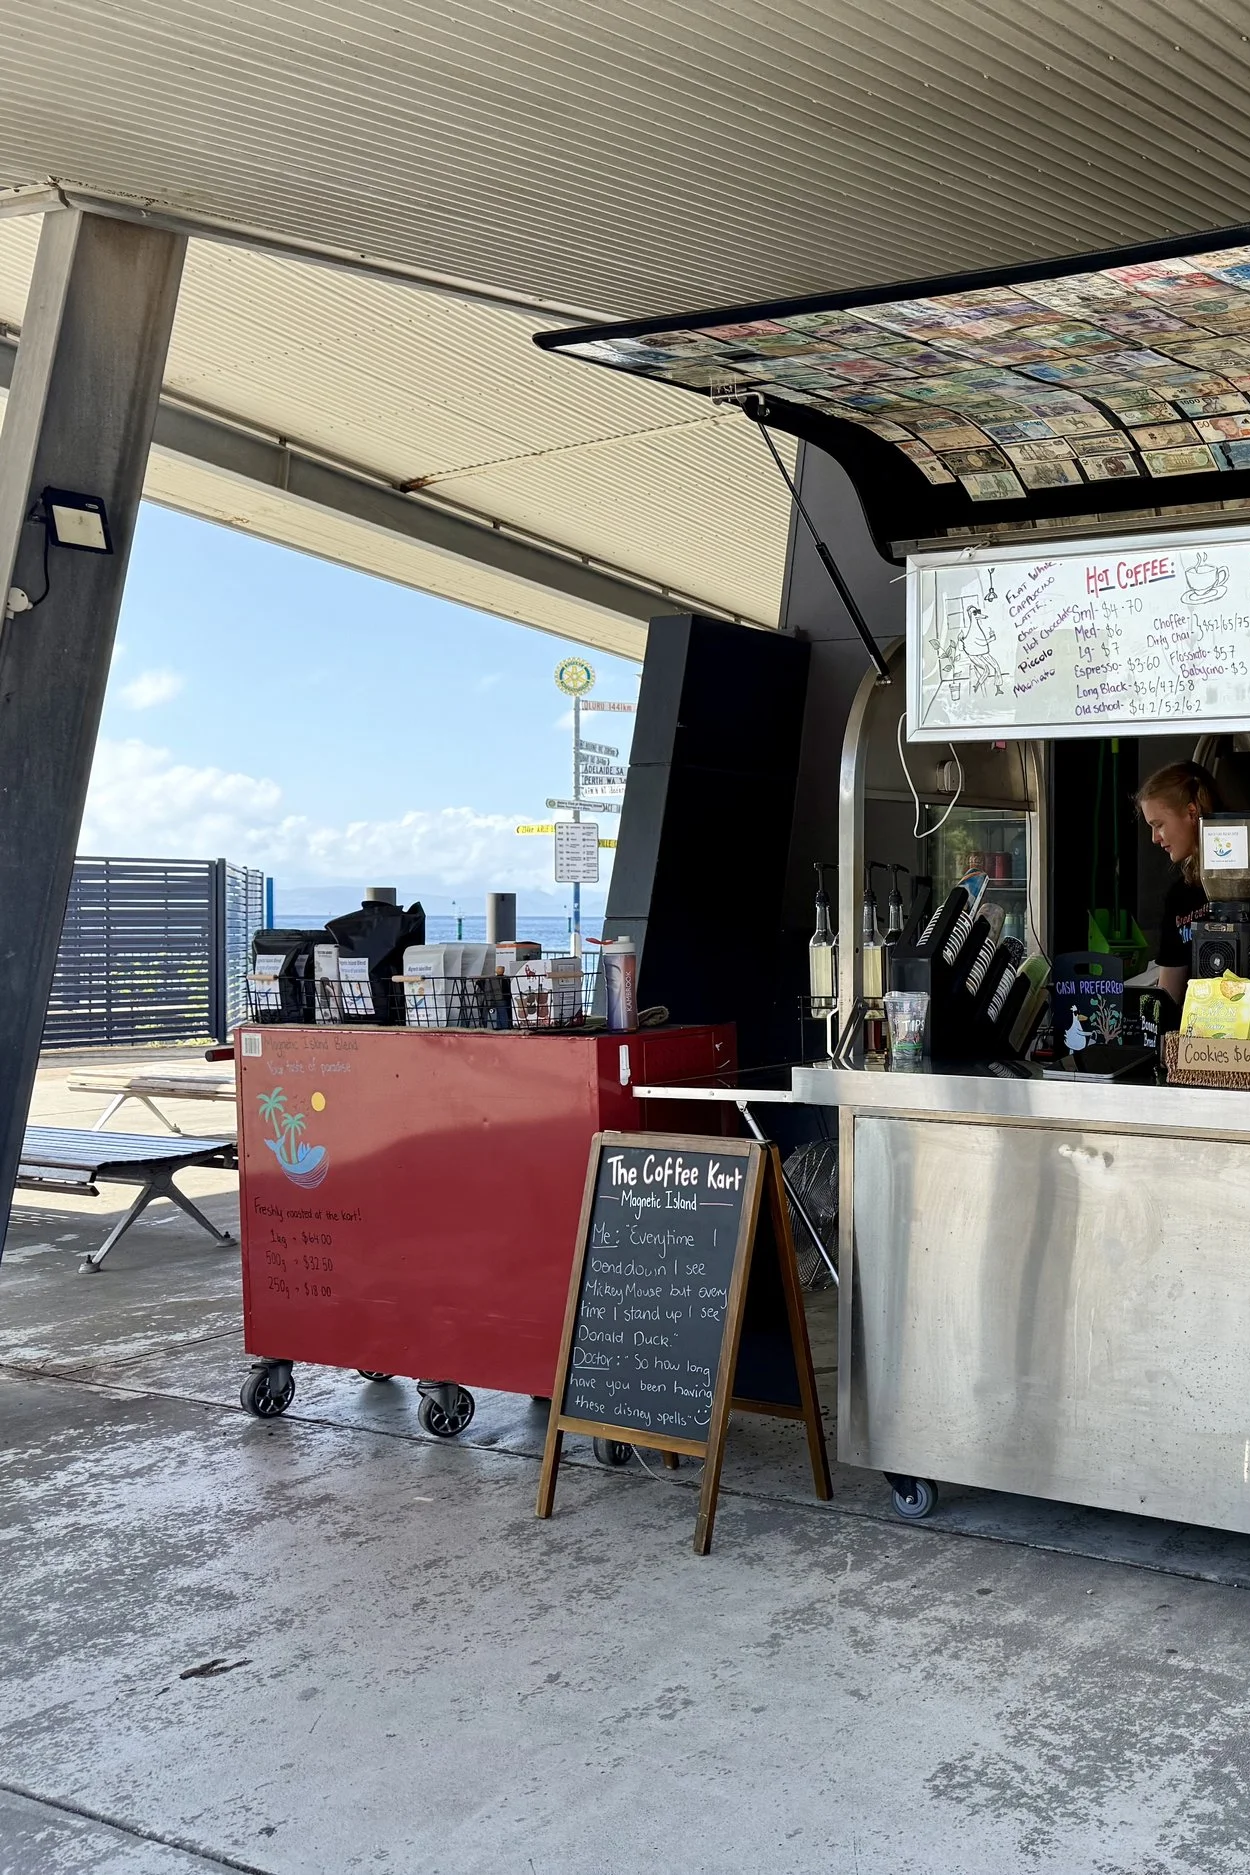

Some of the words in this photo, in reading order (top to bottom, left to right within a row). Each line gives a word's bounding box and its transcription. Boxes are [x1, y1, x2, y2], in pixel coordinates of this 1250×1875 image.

[1106, 624, 1122, 638] $6
[1101, 642, 1119, 658] $7
[1018, 649, 1053, 673] Piccolo
[1231, 661, 1248, 675] $3
[1077, 685, 1098, 699] Long
[584, 765, 613, 774] ADELAIDE
[1056, 981, 1075, 994] CASH
[1080, 980, 1124, 994] PREFERRED
[902, 1020, 925, 1031] TIPS
[1185, 1043, 1230, 1064] Cookies
[1234, 1046, 1250, 1063] $6
[607, 1154, 638, 1187] The
[643, 1154, 700, 1187] Coffee
[707, 1159, 743, 1191] Kart
[254, 1196, 283, 1223] Freshly
[325, 1210, 339, 1221] the
[621, 1190, 661, 1220] Magnetic
[664, 1191, 697, 1211] Island
[624, 1259, 666, 1276] down
[685, 1262, 706, 1276] see
[585, 1279, 624, 1305] Mickey
[625, 1282, 662, 1298] Mouse
[669, 1284, 692, 1298] but
[698, 1287, 728, 1310] every
[580, 1300, 606, 1319] time
[624, 1305, 660, 1321] stand
[666, 1309, 682, 1324] up
[700, 1306, 720, 1322] see
[578, 1324, 624, 1344] Donald
[654, 1356, 681, 1371] how
[687, 1360, 711, 1388] long
[570, 1373, 597, 1389] have
[606, 1380, 630, 1397] you
[641, 1380, 667, 1393] been
[674, 1380, 713, 1408] having
[575, 1395, 605, 1414] these
[614, 1402, 651, 1427] disney
